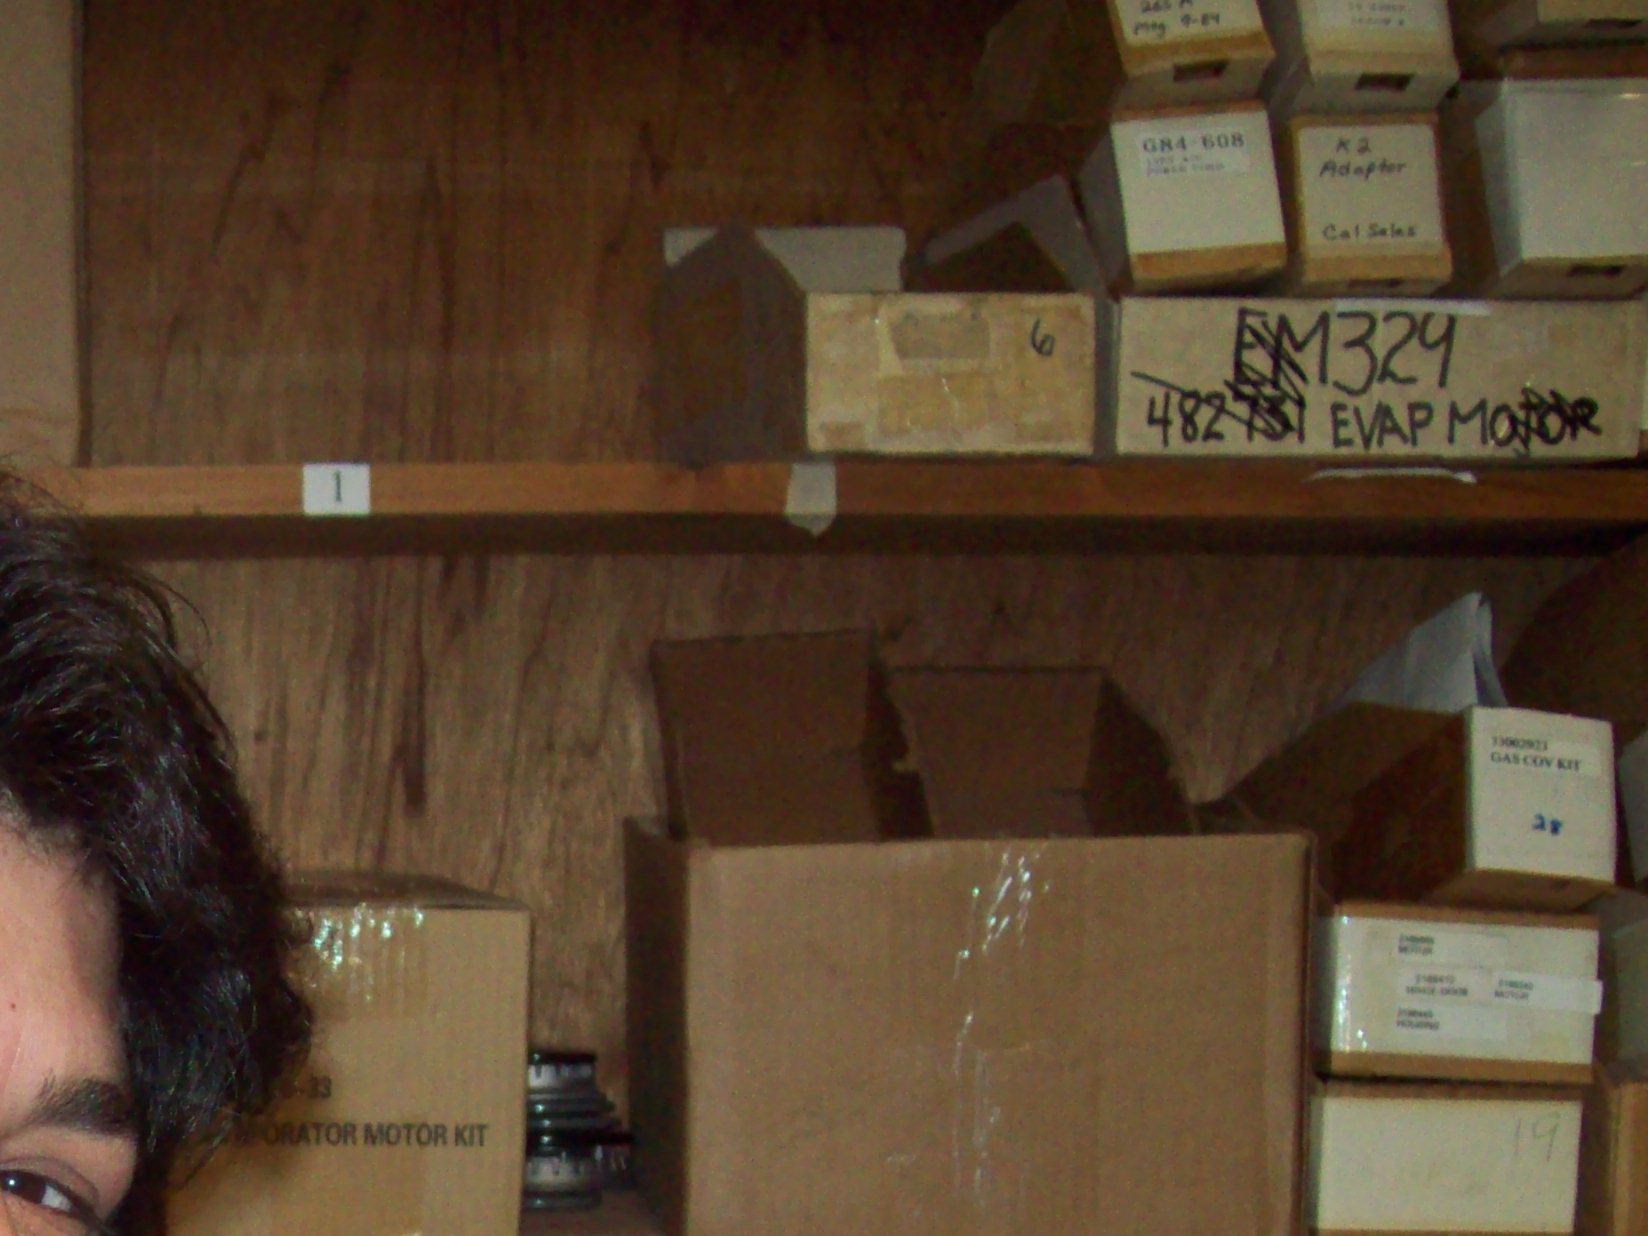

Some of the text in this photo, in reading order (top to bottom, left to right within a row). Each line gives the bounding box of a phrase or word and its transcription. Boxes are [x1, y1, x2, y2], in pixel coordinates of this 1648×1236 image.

[1330, 402, 1434, 450] EVAP
[332, 468, 343, 503] 1
[1556, 757, 1582, 772] KIT
[363, 1122, 449, 1147] MOTOR
[454, 1123, 489, 1147] KIT
